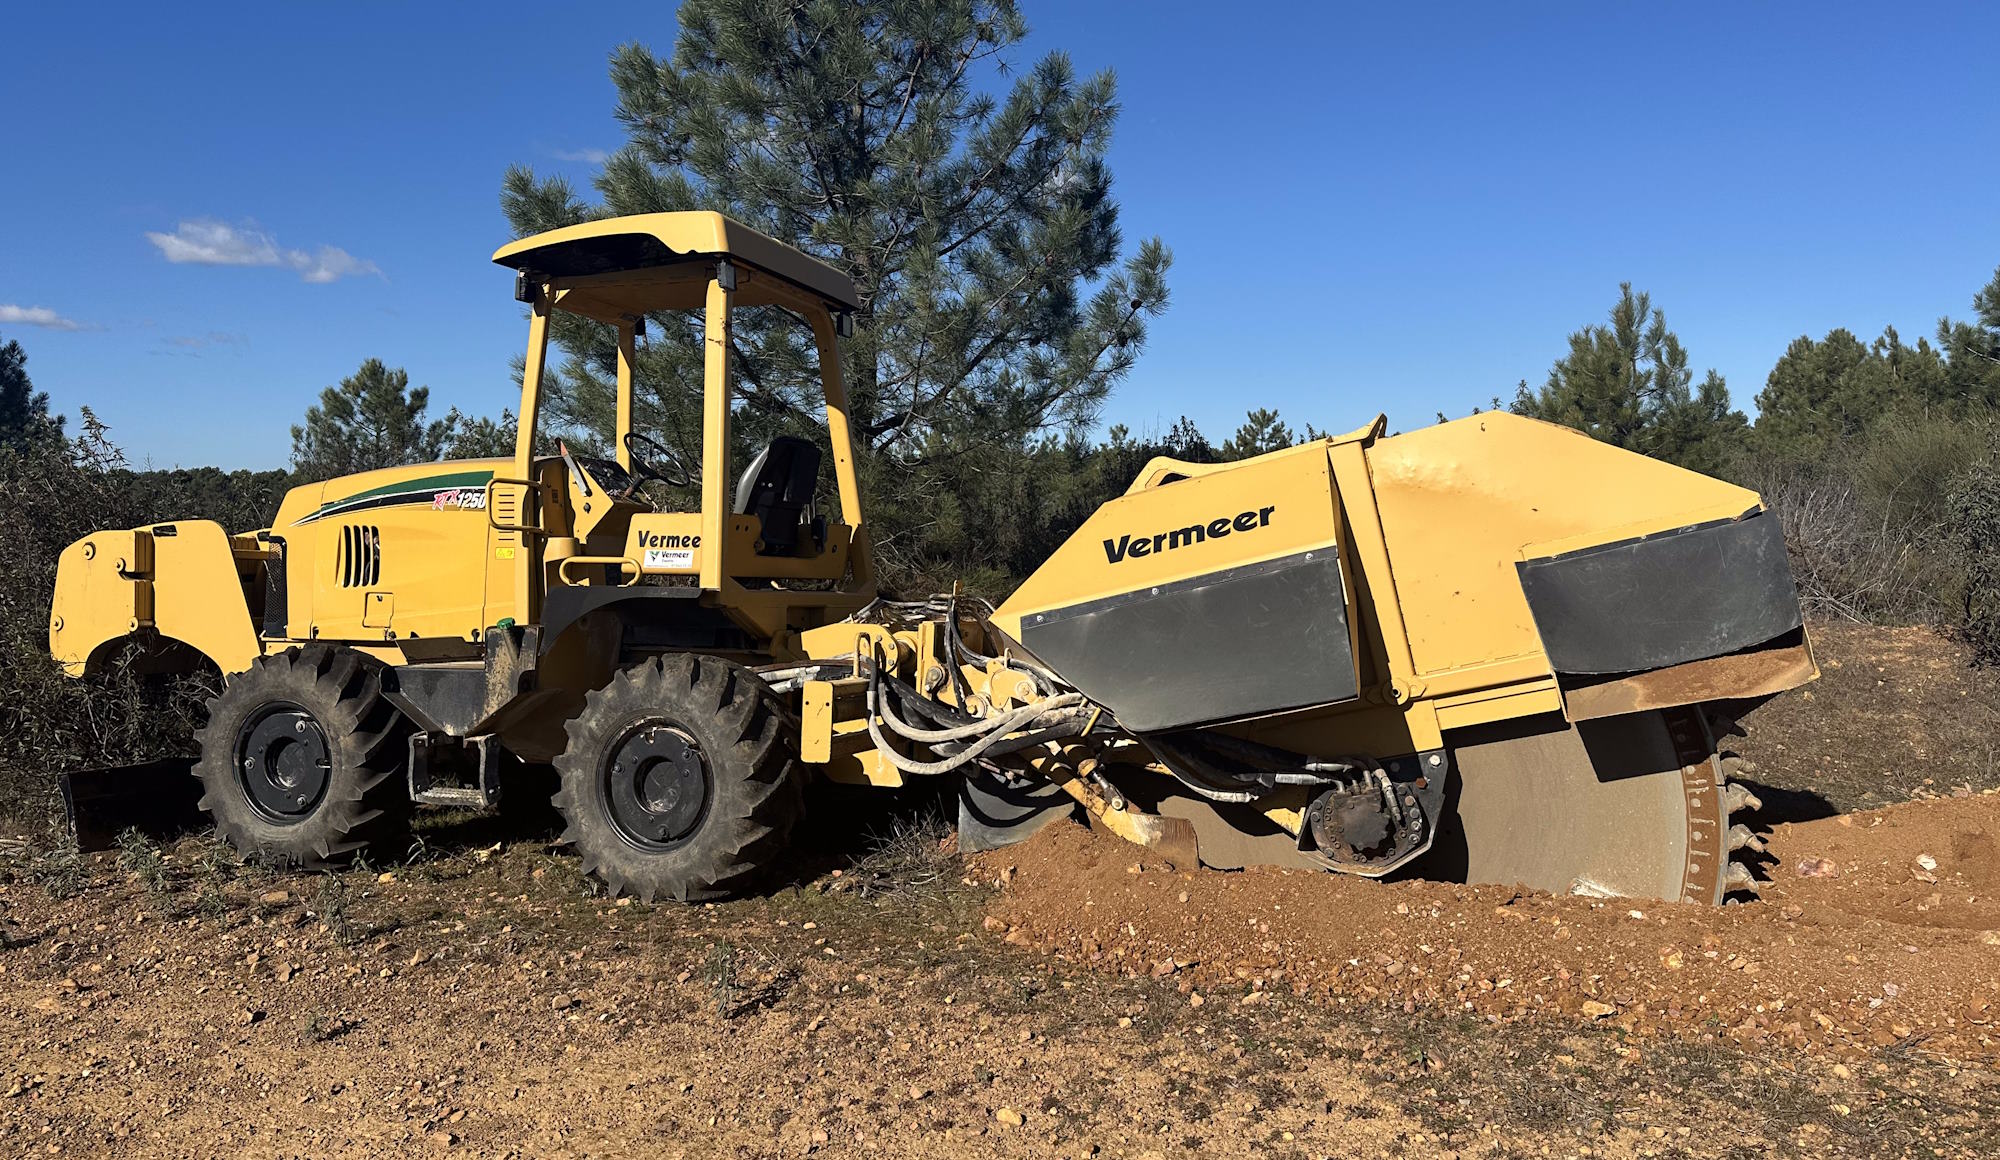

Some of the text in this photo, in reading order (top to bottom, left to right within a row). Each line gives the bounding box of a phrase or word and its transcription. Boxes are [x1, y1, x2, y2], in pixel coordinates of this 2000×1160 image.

[638, 530, 702, 548] Vermee
[1102, 505, 1275, 564] Vermeer
[661, 551, 690, 559] Vermeer
